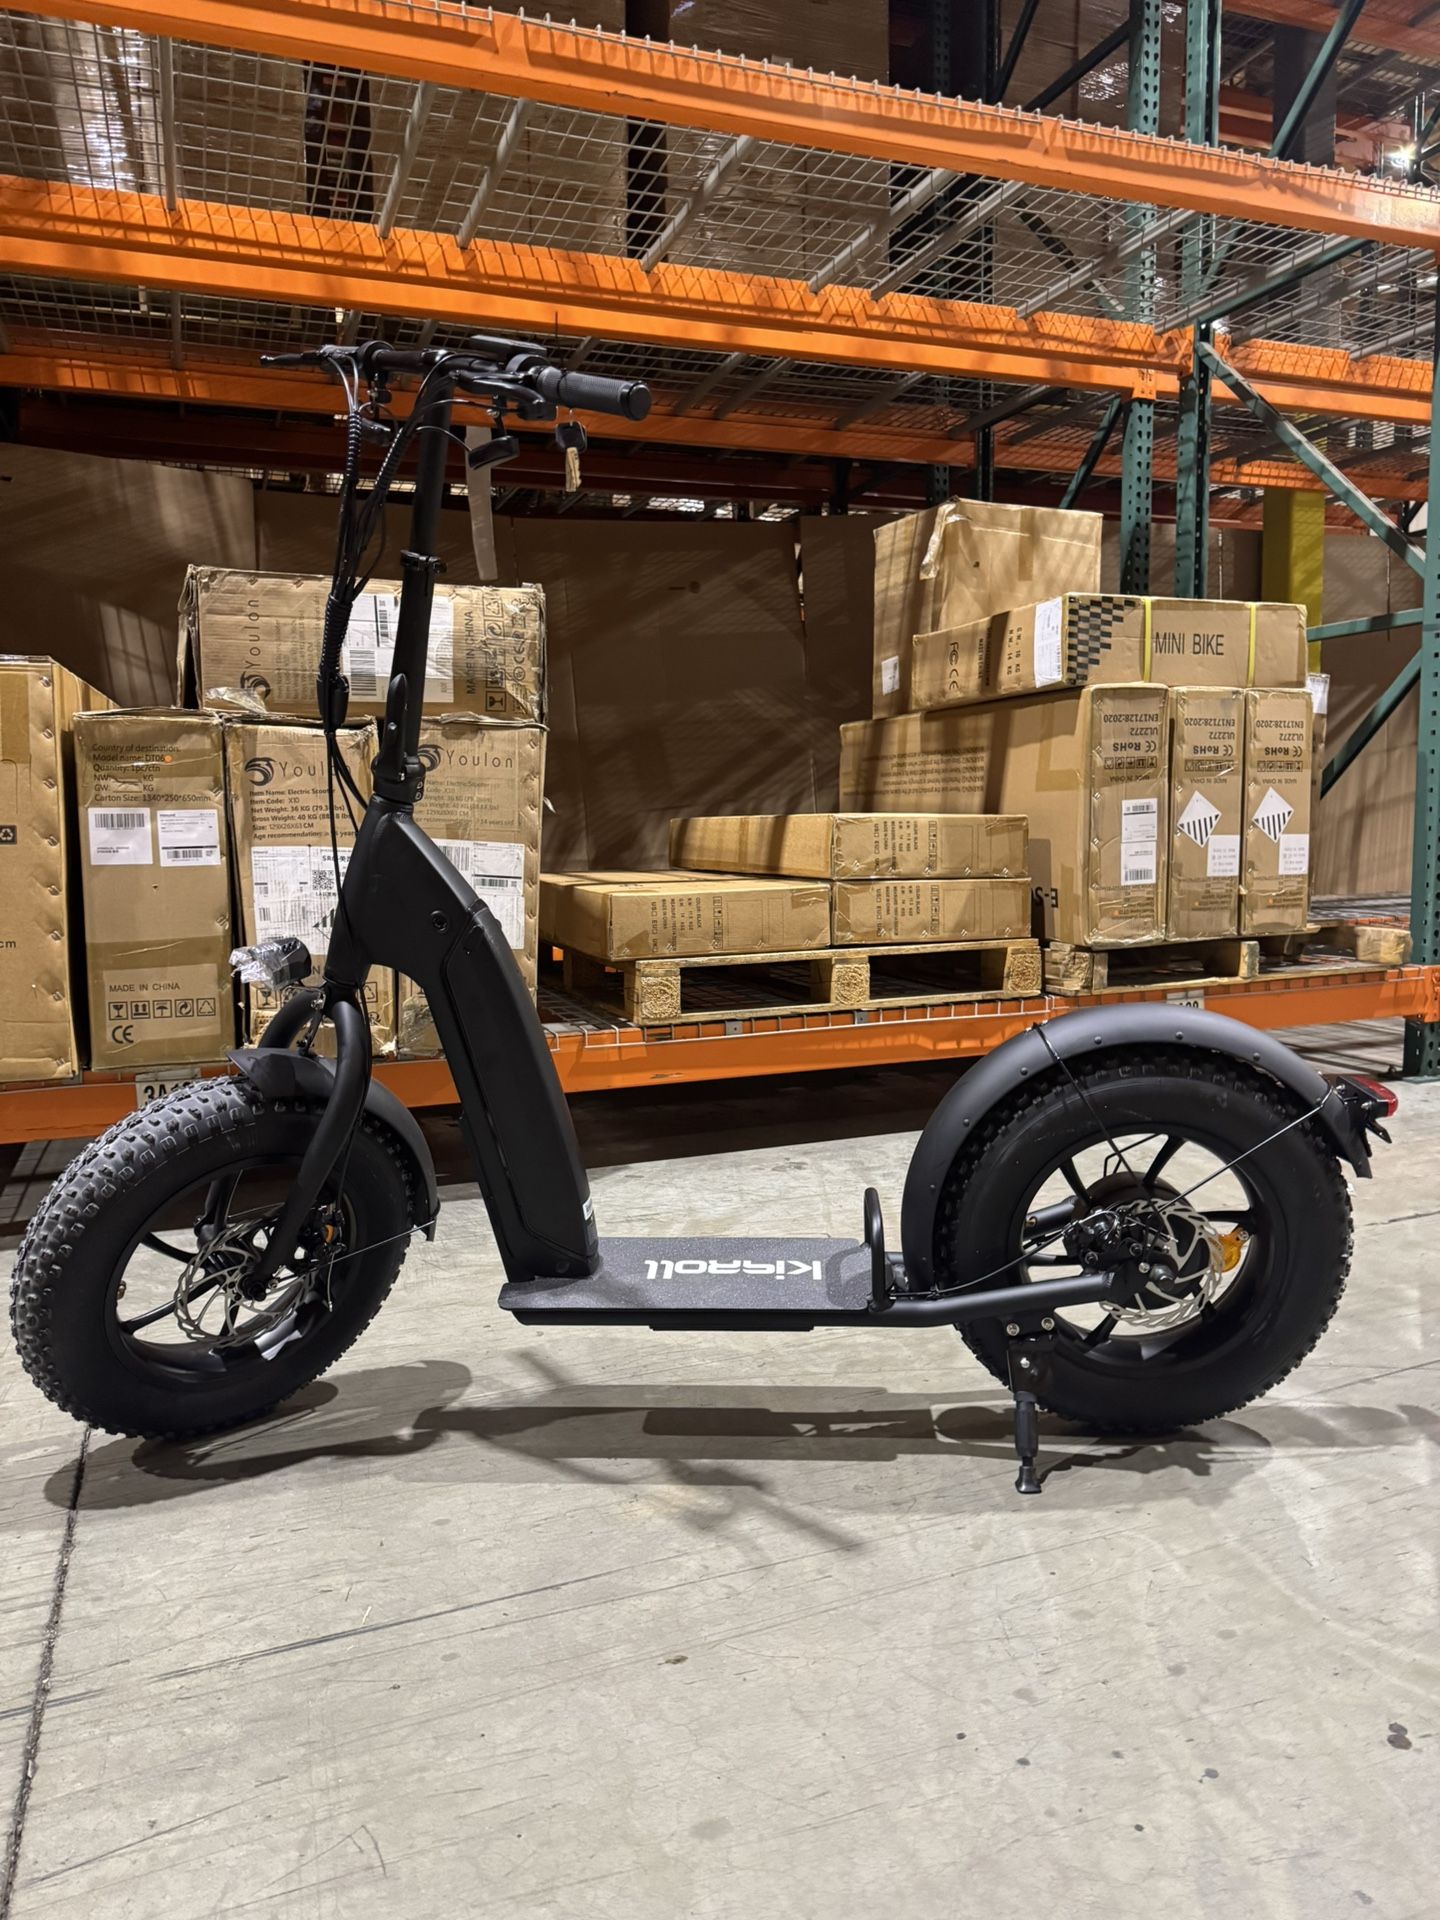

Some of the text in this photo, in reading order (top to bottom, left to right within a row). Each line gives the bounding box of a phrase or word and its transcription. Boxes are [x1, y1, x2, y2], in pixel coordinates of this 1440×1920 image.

[244, 599, 261, 669] Youlon
[1154, 633, 1225, 656] MINI BIKE
[464, 610, 476, 695] MADE IN CHINA
[1103, 713, 1158, 723] EN17128:2020
[1184, 718, 1235, 727] EN17128:2020
[1256, 720, 1304, 729] EN17128:2020
[1129, 727, 1158, 736] UL2272
[1209, 731, 1235, 740] UL2272
[1279, 733, 1304, 741] UL2272
[93, 744, 125, 753] Country
[126, 743, 134, 751] of
[1112, 742, 1141, 752] RoHS
[1192, 745, 1219, 754] RoHS
[1264, 746, 1289, 756] RoHS
[446, 750, 513, 768] Youlon
[278, 761, 351, 777] Youl
[264, 807, 289, 815] Weight:
[271, 815, 296, 823] Weight:
[253, 833, 266, 841] Age
[1032, 886, 1058, 908] E-S
[109, 983, 181, 992] MADE IN CHINA
